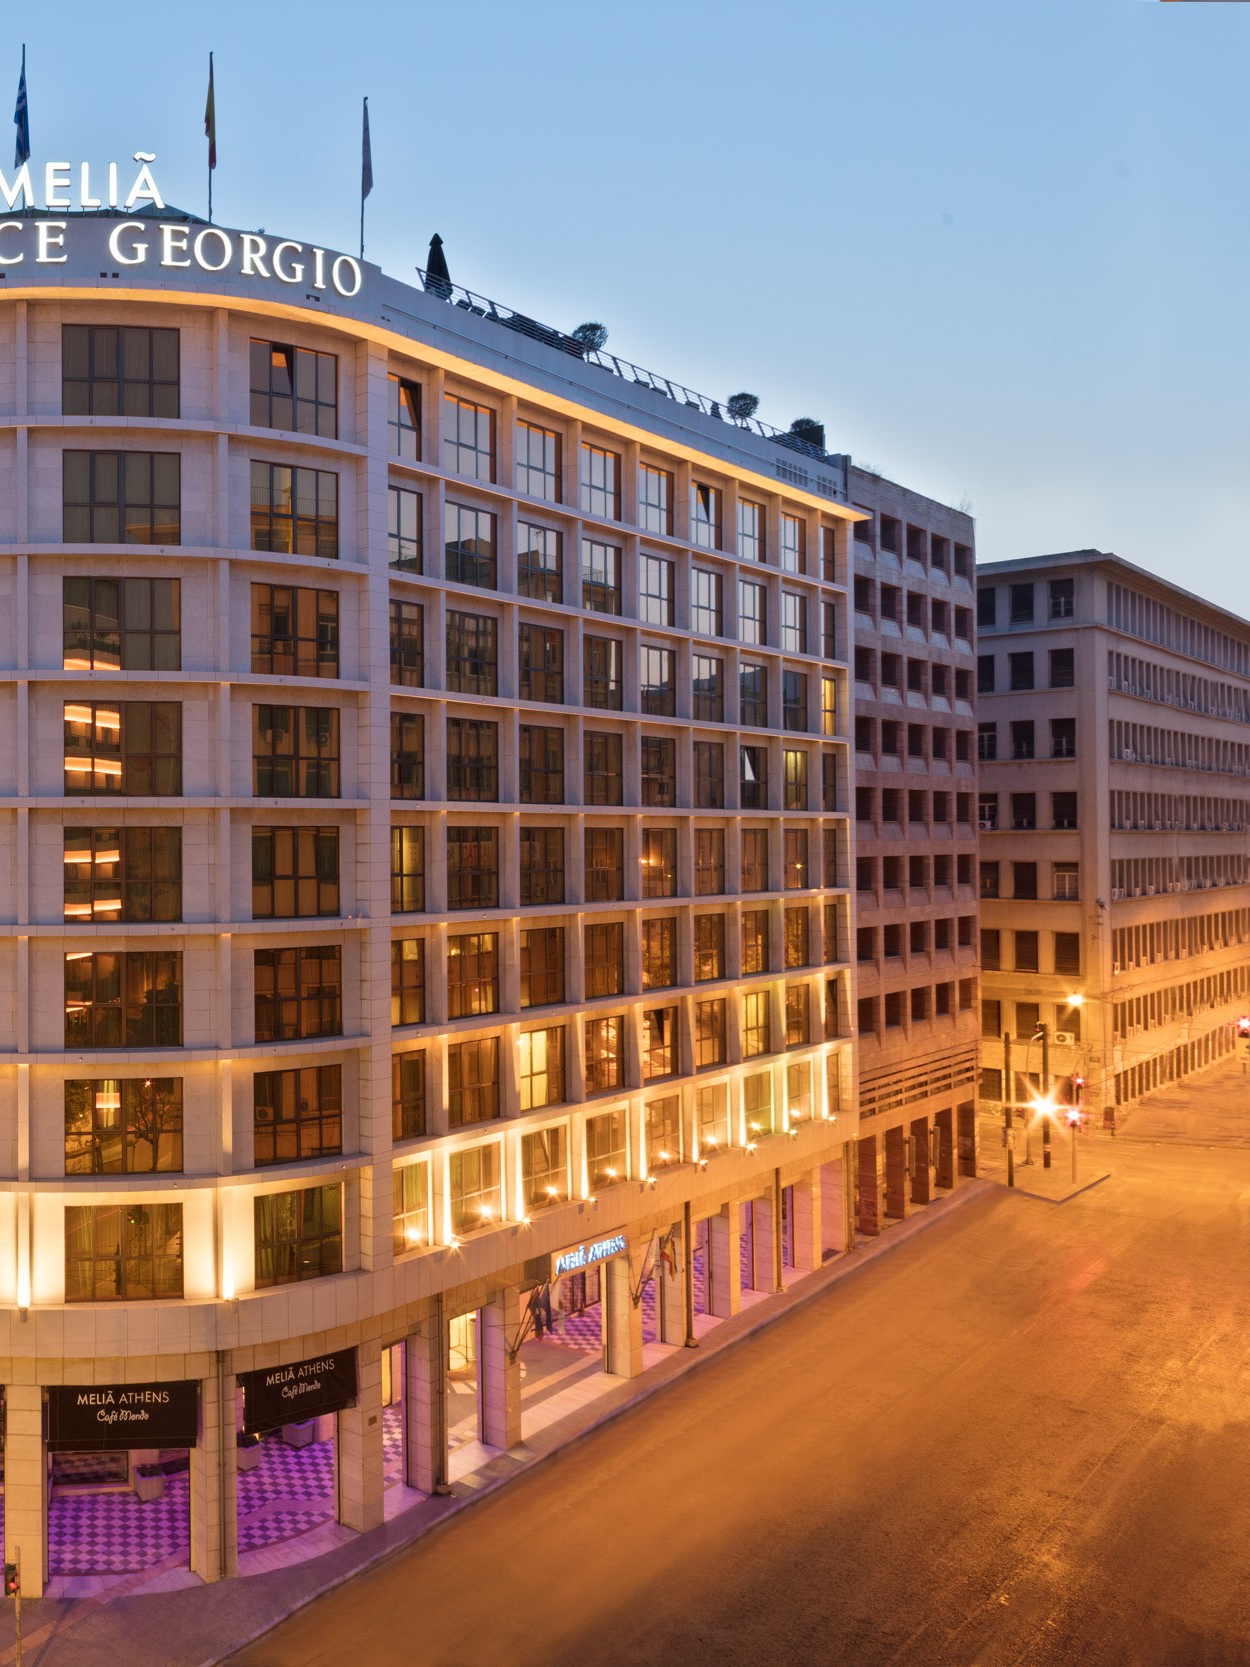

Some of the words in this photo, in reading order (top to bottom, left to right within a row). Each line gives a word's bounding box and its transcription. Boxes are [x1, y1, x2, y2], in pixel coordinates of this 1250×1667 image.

[108, 220, 363, 297] GEORGIO
[265, 1366, 295, 1386] MELIÃ
[297, 1359, 335, 1379] ATHENS
[76, 1390, 115, 1405] MELIÃ
[118, 1390, 170, 1405] ATHENS
[281, 1384, 299, 1399] Café
[298, 1380, 321, 1394] Mondo
[96, 1408, 118, 1425] Café
[118, 1409, 150, 1421] Mondo
